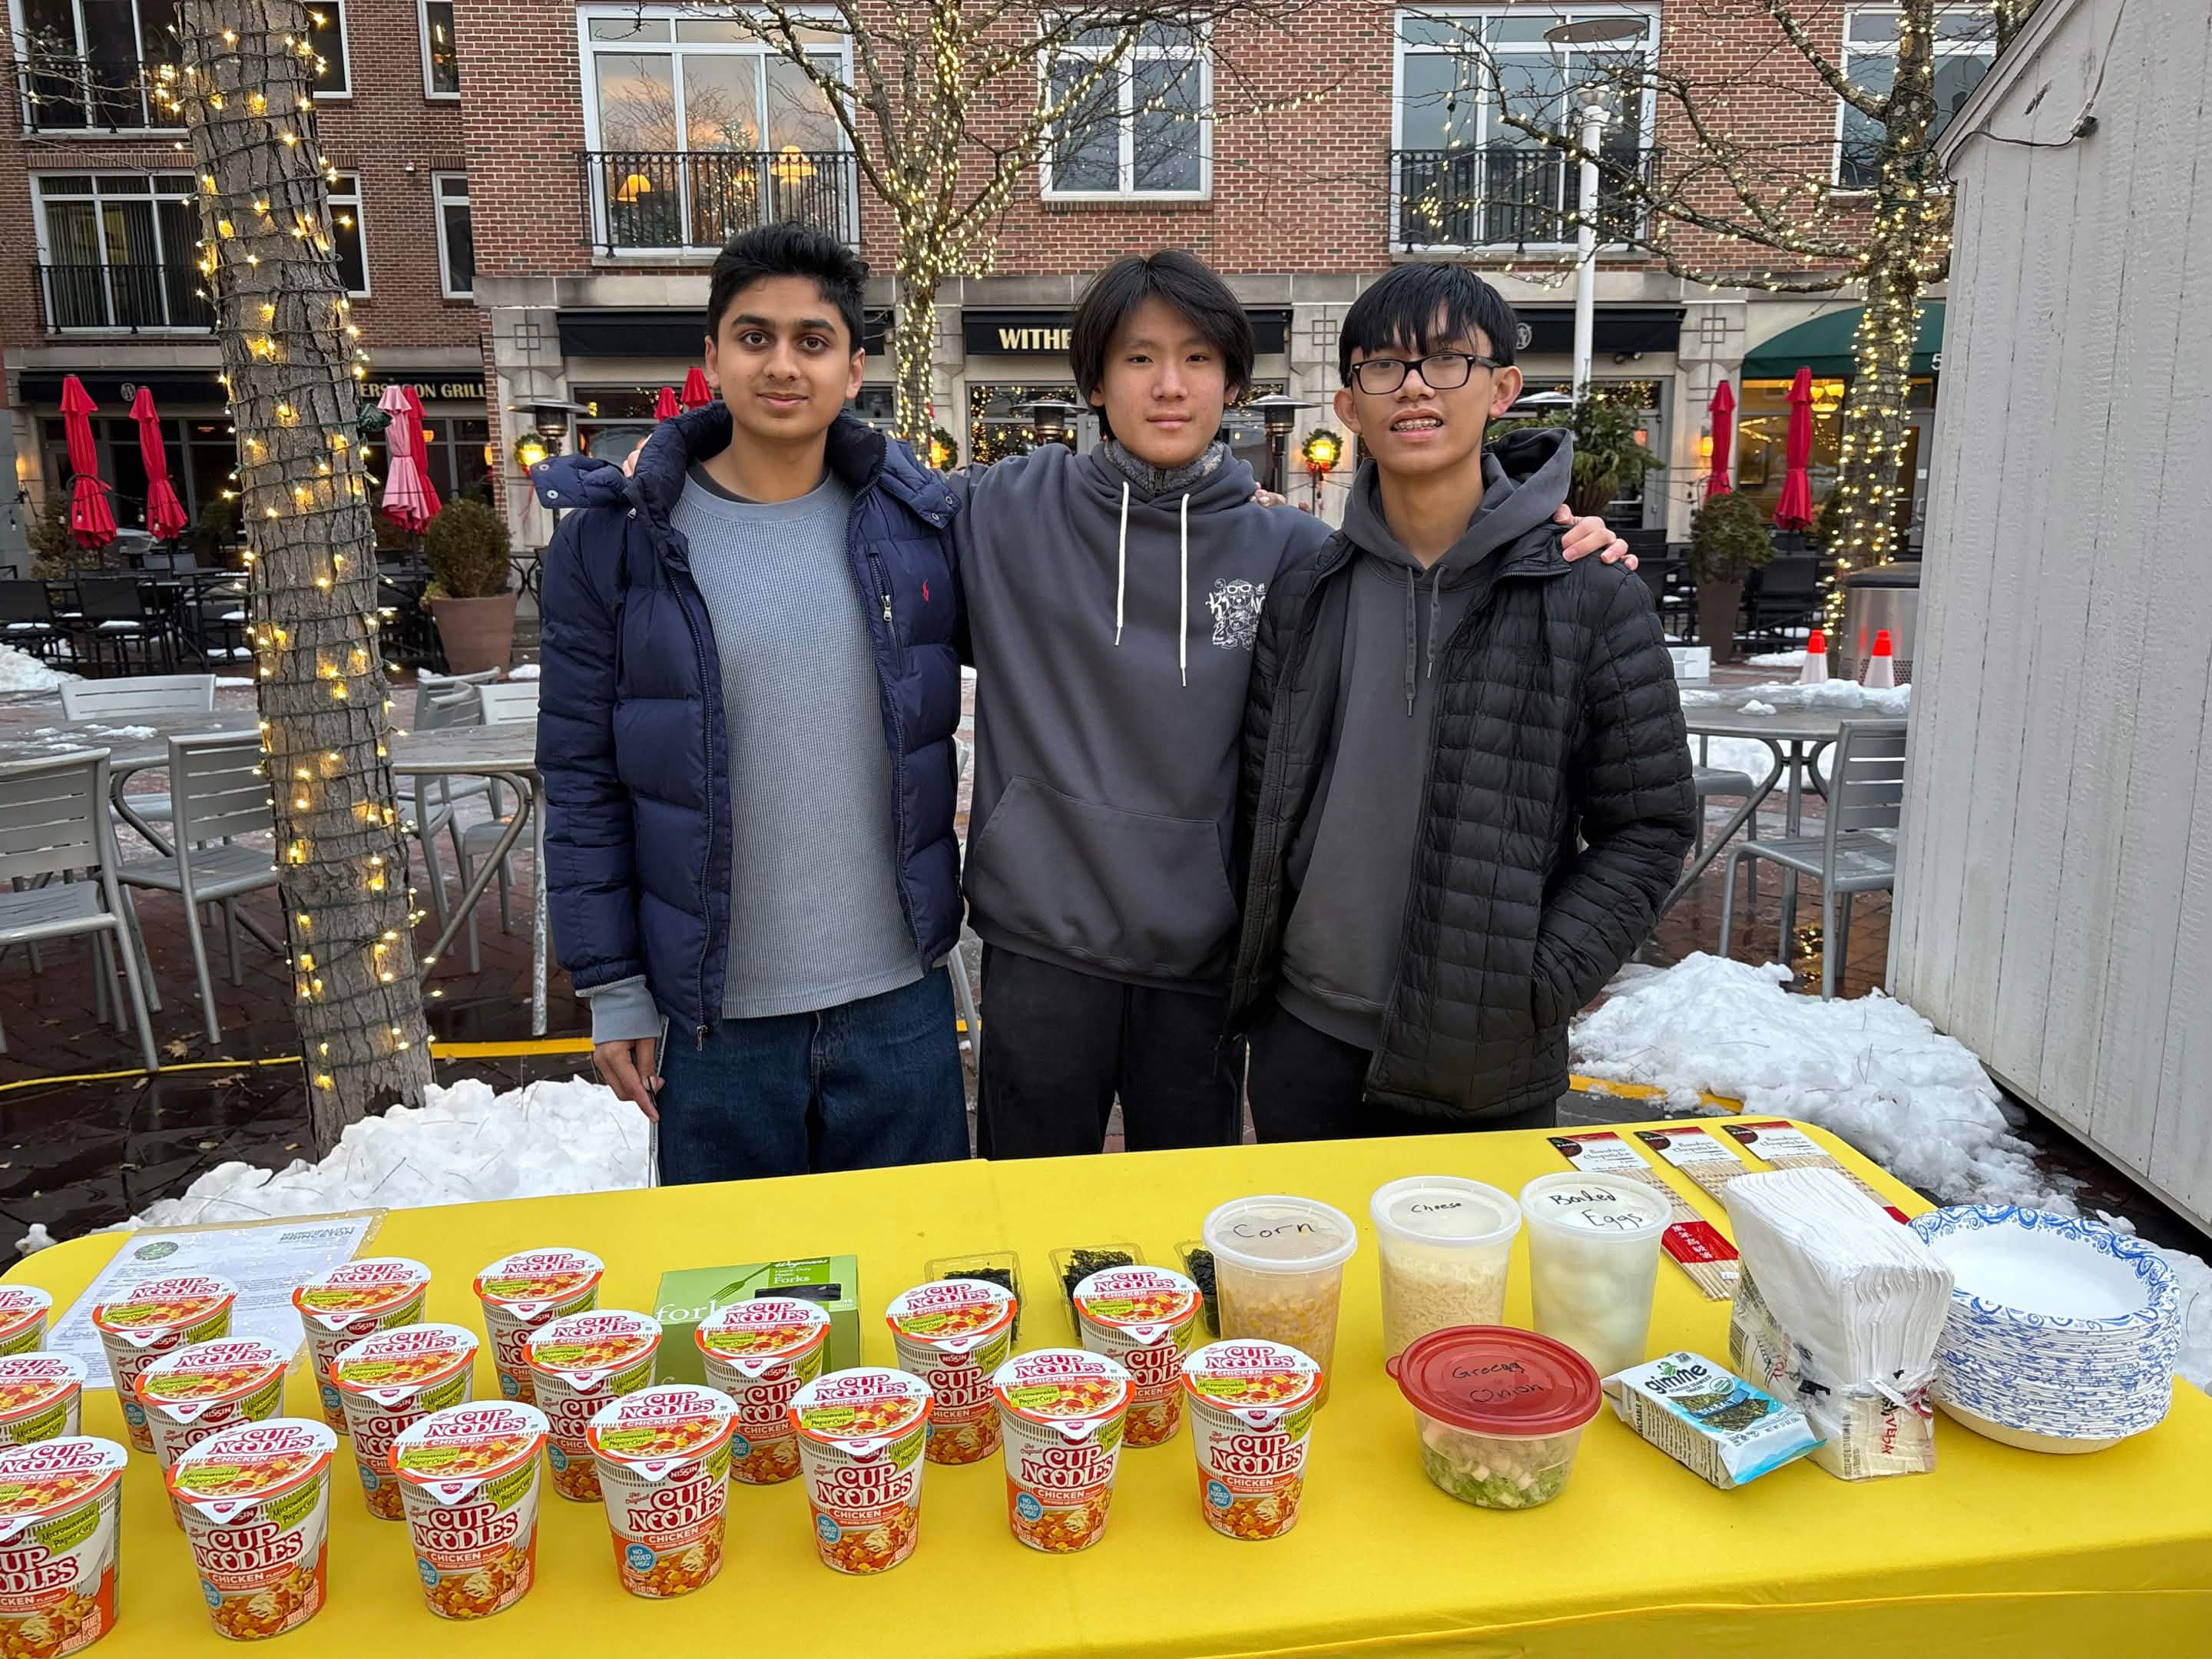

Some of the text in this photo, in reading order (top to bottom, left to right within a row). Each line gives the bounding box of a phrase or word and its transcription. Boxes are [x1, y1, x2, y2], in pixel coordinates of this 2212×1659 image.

[441, 383, 486, 398] GRILL
[1548, 1187, 1616, 1205] Boiled
[1411, 1203, 1462, 1213] Cheese
[1581, 1209, 1642, 1230] Eggs
[1233, 1223, 1315, 1238] Corn
[502, 1260, 585, 1273] NOODLES
[526, 1253, 573, 1265] CUP
[355, 1263, 403, 1273] CUP
[157, 1277, 209, 1288] CUP
[326, 1270, 412, 1283] NOODLES
[774, 1275, 811, 1284] Forks
[1111, 1272, 1157, 1281] CUP
[127, 1283, 220, 1300] NOODLES
[925, 1283, 971, 1296] CUP
[1094, 1279, 1176, 1292] NOODLES
[908, 1290, 990, 1310] NOODLES
[747, 1303, 796, 1313] CUP
[577, 1316, 627, 1328] CUP
[723, 1310, 810, 1325] NOODLES
[348, 1321, 375, 1332] NISSIN
[552, 1323, 641, 1337] NOODLES
[389, 1330, 443, 1343] CUP
[205, 1343, 261, 1353] CUP
[362, 1336, 456, 1355] NOODLES
[1224, 1346, 1275, 1359] CUP
[4, 1359, 61, 1369] CUP
[173, 1349, 271, 1368] NOODLES
[942, 1353, 968, 1363] NISSIN
[1034, 1355, 1084, 1367] CUP
[1124, 1345, 1178, 1370] CUP
[1205, 1354, 1296, 1369] NOODLES
[762, 1367, 787, 1378] NISSIN
[927, 1366, 984, 1389] CUP
[1015, 1362, 1106, 1379] NOODLES
[837, 1375, 890, 1389] CUP
[1644, 1363, 1708, 1395] gimme
[644, 1391, 699, 1406] CUP
[745, 1377, 803, 1406] CUP
[815, 1382, 908, 1401] NOODLES
[1470, 1382, 1544, 1402] Onion
[202, 1407, 231, 1419] NISSIN
[455, 1409, 512, 1424] CUP
[618, 1399, 715, 1419] NOODLES
[17, 1409, 63, 1439] Microwavable
[424, 1419, 525, 1438] NOODLES
[745, 1423, 788, 1434] CHICKEN
[242, 1426, 302, 1442] CUP
[603, 1432, 654, 1443] Microwavable
[208, 1435, 314, 1455] NOODLES
[608, 1437, 646, 1448] Paper Cup
[1230, 1433, 1292, 1457] CUP
[32, 1442, 93, 1459] CUP
[1043, 1444, 1104, 1469] CUP
[0, 1452, 104, 1473] NOODLES
[1210, 1443, 1304, 1477] NOODLES
[671, 1465, 700, 1479] NISSIN
[835, 1462, 899, 1488] CUP
[1022, 1454, 1114, 1488] NOODLES
[492, 1465, 534, 1498] Microwavable
[1227, 1477, 1274, 1487] CHICKEN
[501, 1477, 532, 1504] Paper Cup
[651, 1475, 714, 1511] CUP
[816, 1472, 912, 1509] NOODLES
[1038, 1489, 1084, 1499] CHICKEN
[273, 1482, 317, 1518] Microwavable
[625, 1494, 650, 1505] Original
[283, 1497, 316, 1524] Paper Cup
[629, 1483, 725, 1533] NOODLES
[833, 1509, 882, 1519] CHICKEN
[429, 1503, 498, 1530] CUP
[41, 1508, 96, 1542] Microwavable
[412, 1511, 518, 1551] NOODLES
[54, 1522, 94, 1549] Paper Cup
[208, 1522, 280, 1551] CUP
[649, 1527, 699, 1544] CHICKEN
[194, 1531, 303, 1573] NOODLES
[431, 1552, 482, 1562] CHICKEN
[630, 1554, 652, 1562] ADDED
[0, 1547, 49, 1573] UP
[634, 1559, 650, 1568] MSG
[213, 1573, 264, 1584] CHICKEN
